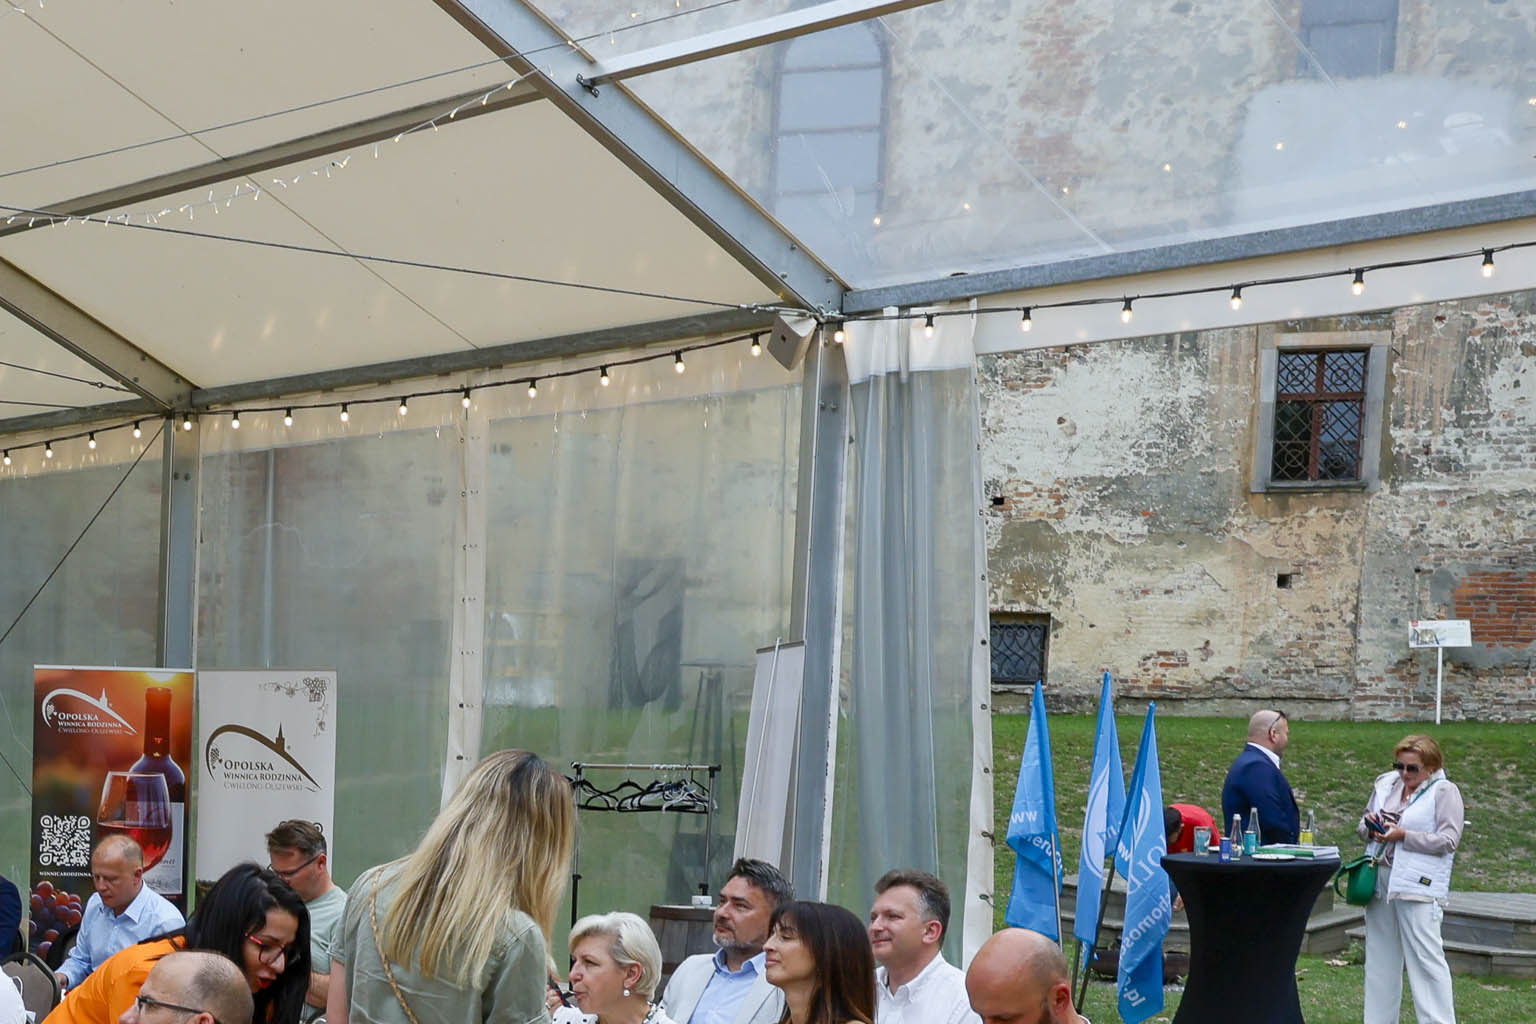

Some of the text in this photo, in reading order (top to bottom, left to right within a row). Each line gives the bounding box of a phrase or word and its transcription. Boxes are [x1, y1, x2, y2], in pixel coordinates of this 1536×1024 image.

[58, 712, 99, 721] OPOLSKA
[224, 759, 274, 771] OPOLSKA
[223, 772, 302, 782] WINNICA RODZINNA
